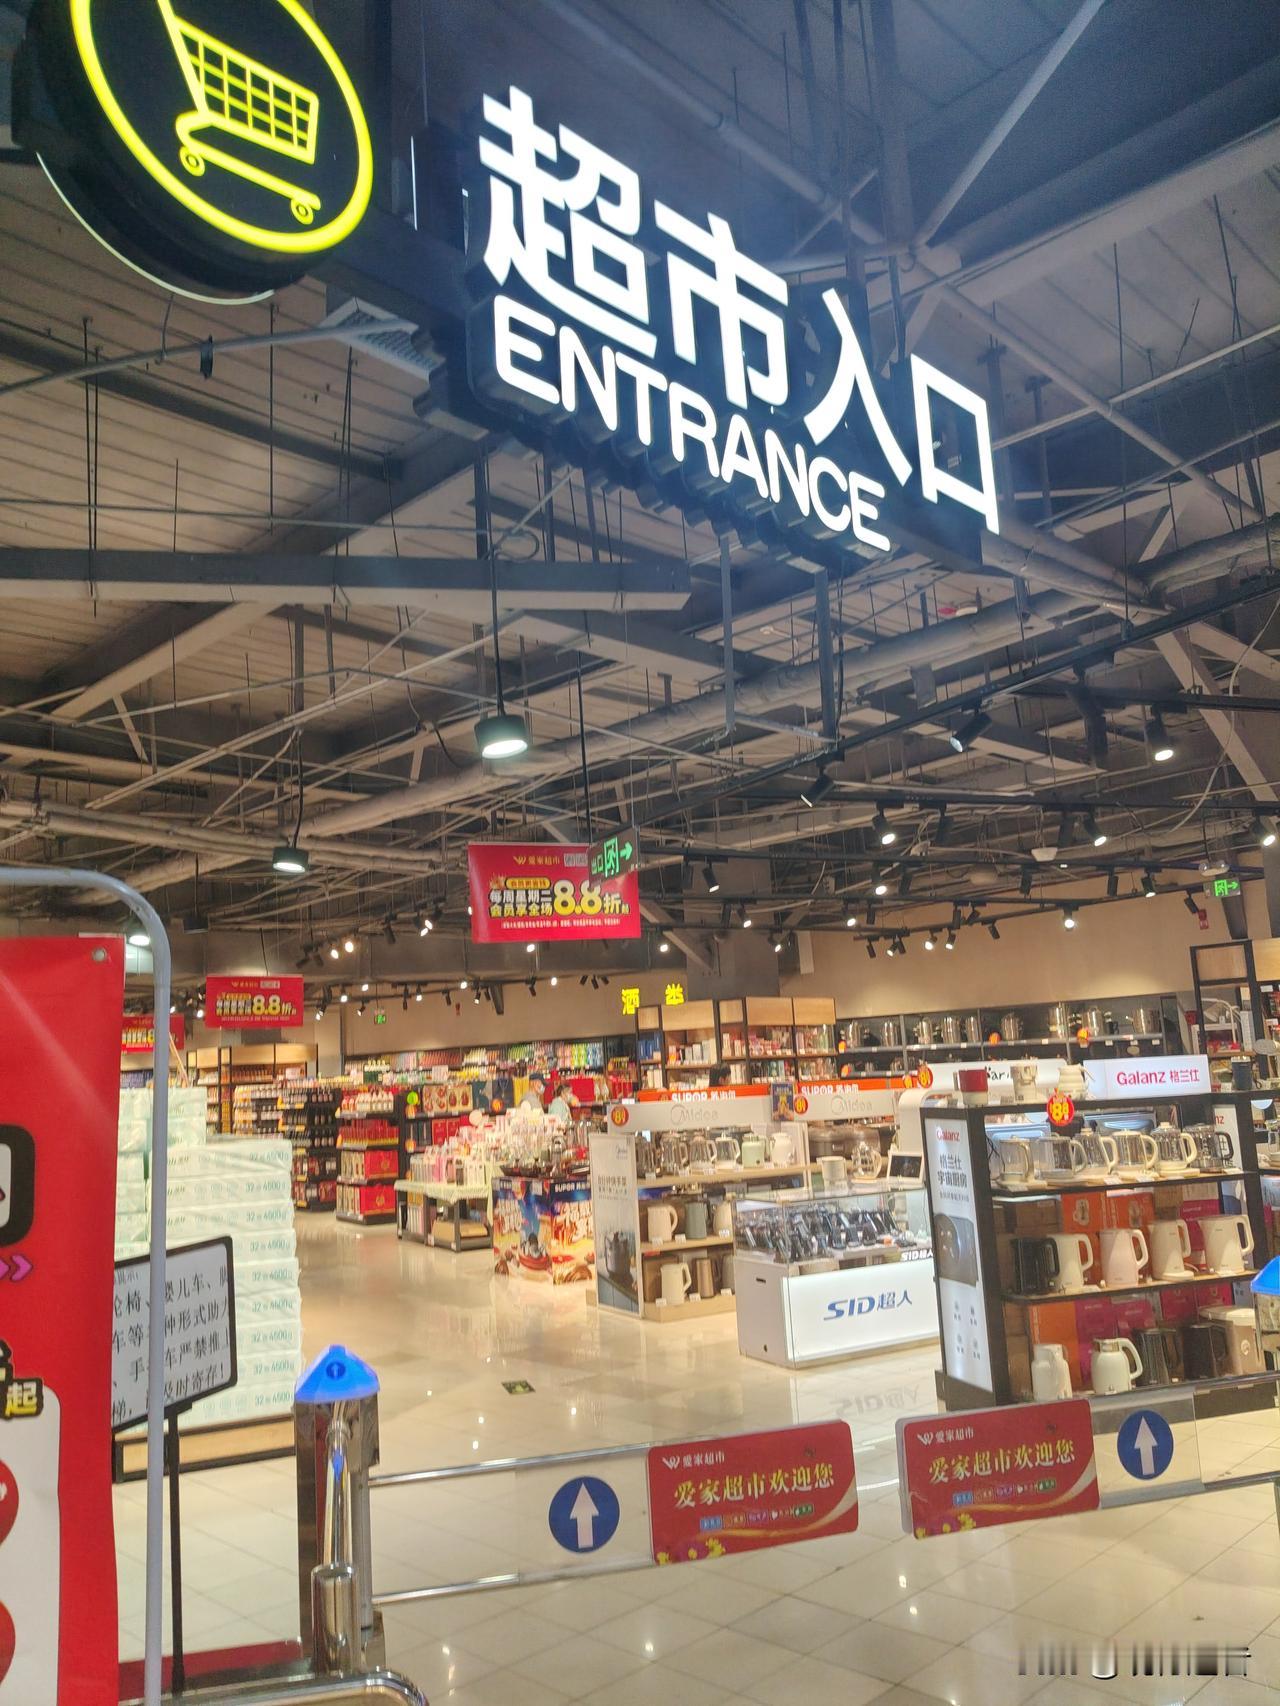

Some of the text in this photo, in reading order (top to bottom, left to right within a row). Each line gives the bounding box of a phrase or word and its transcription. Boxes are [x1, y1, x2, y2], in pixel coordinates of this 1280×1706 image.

[479, 85, 999, 535] 超市入口
[494, 294, 891, 552] ENTRANCE
[1116, 1069, 1200, 1085] Galanz 格兰仕
[824, 1289, 913, 1321] SID超人
[928, 1439, 1076, 1485] 爱家超市欢迎您
[674, 1462, 835, 1509] 爱家超市欢迎您
